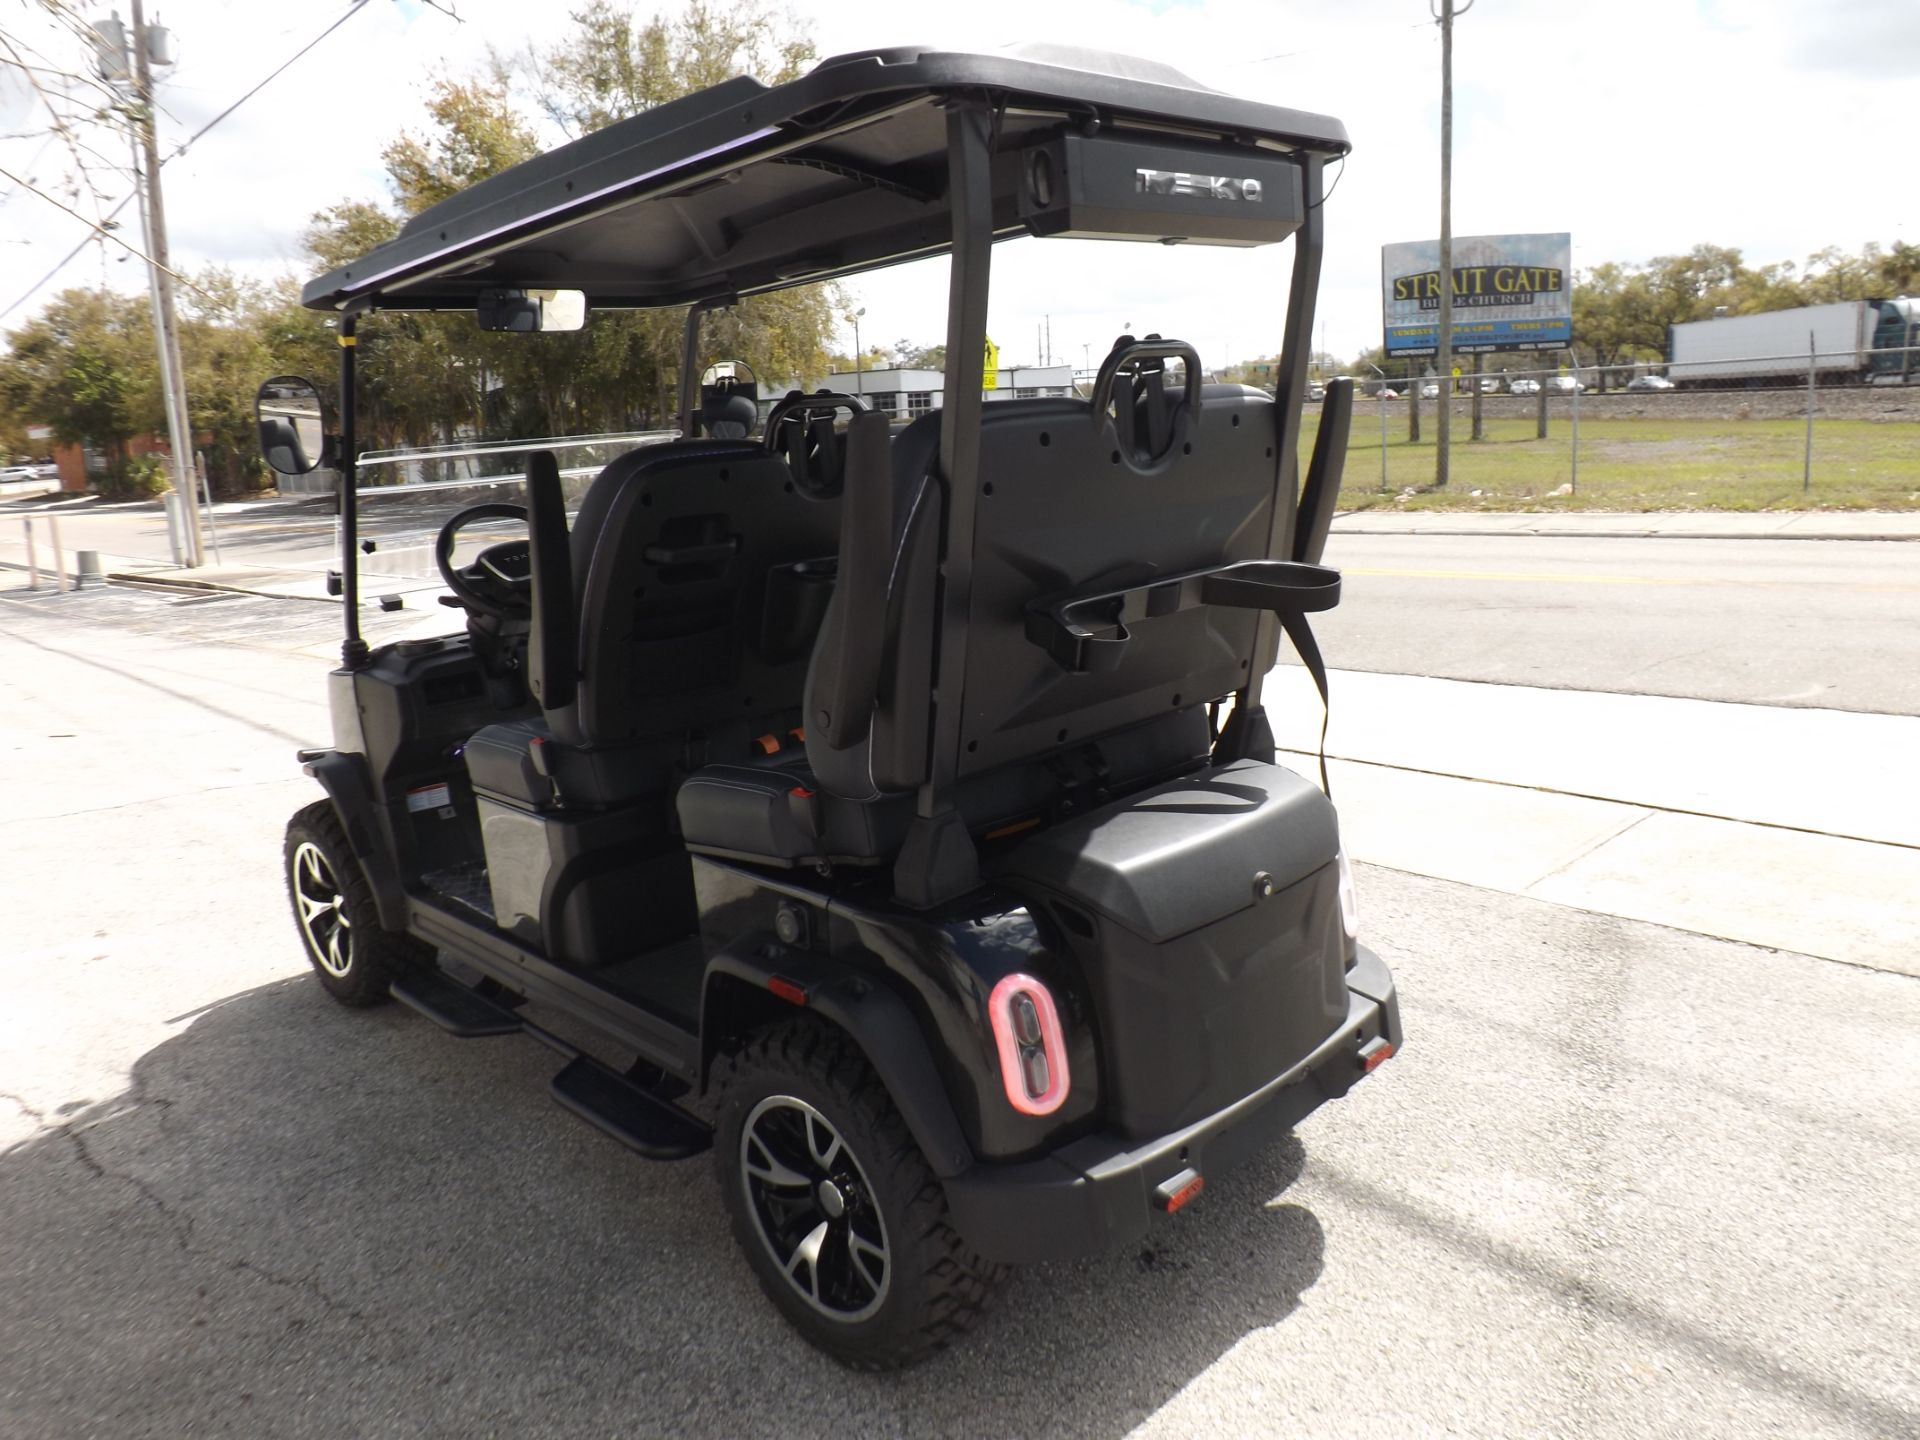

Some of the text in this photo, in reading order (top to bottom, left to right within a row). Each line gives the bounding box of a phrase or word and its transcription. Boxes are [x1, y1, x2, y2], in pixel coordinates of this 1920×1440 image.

[1135, 168, 1263, 203] TEKO
[1494, 267, 1561, 293] GATE
[1422, 293, 1532, 309] BIE CHURCH
